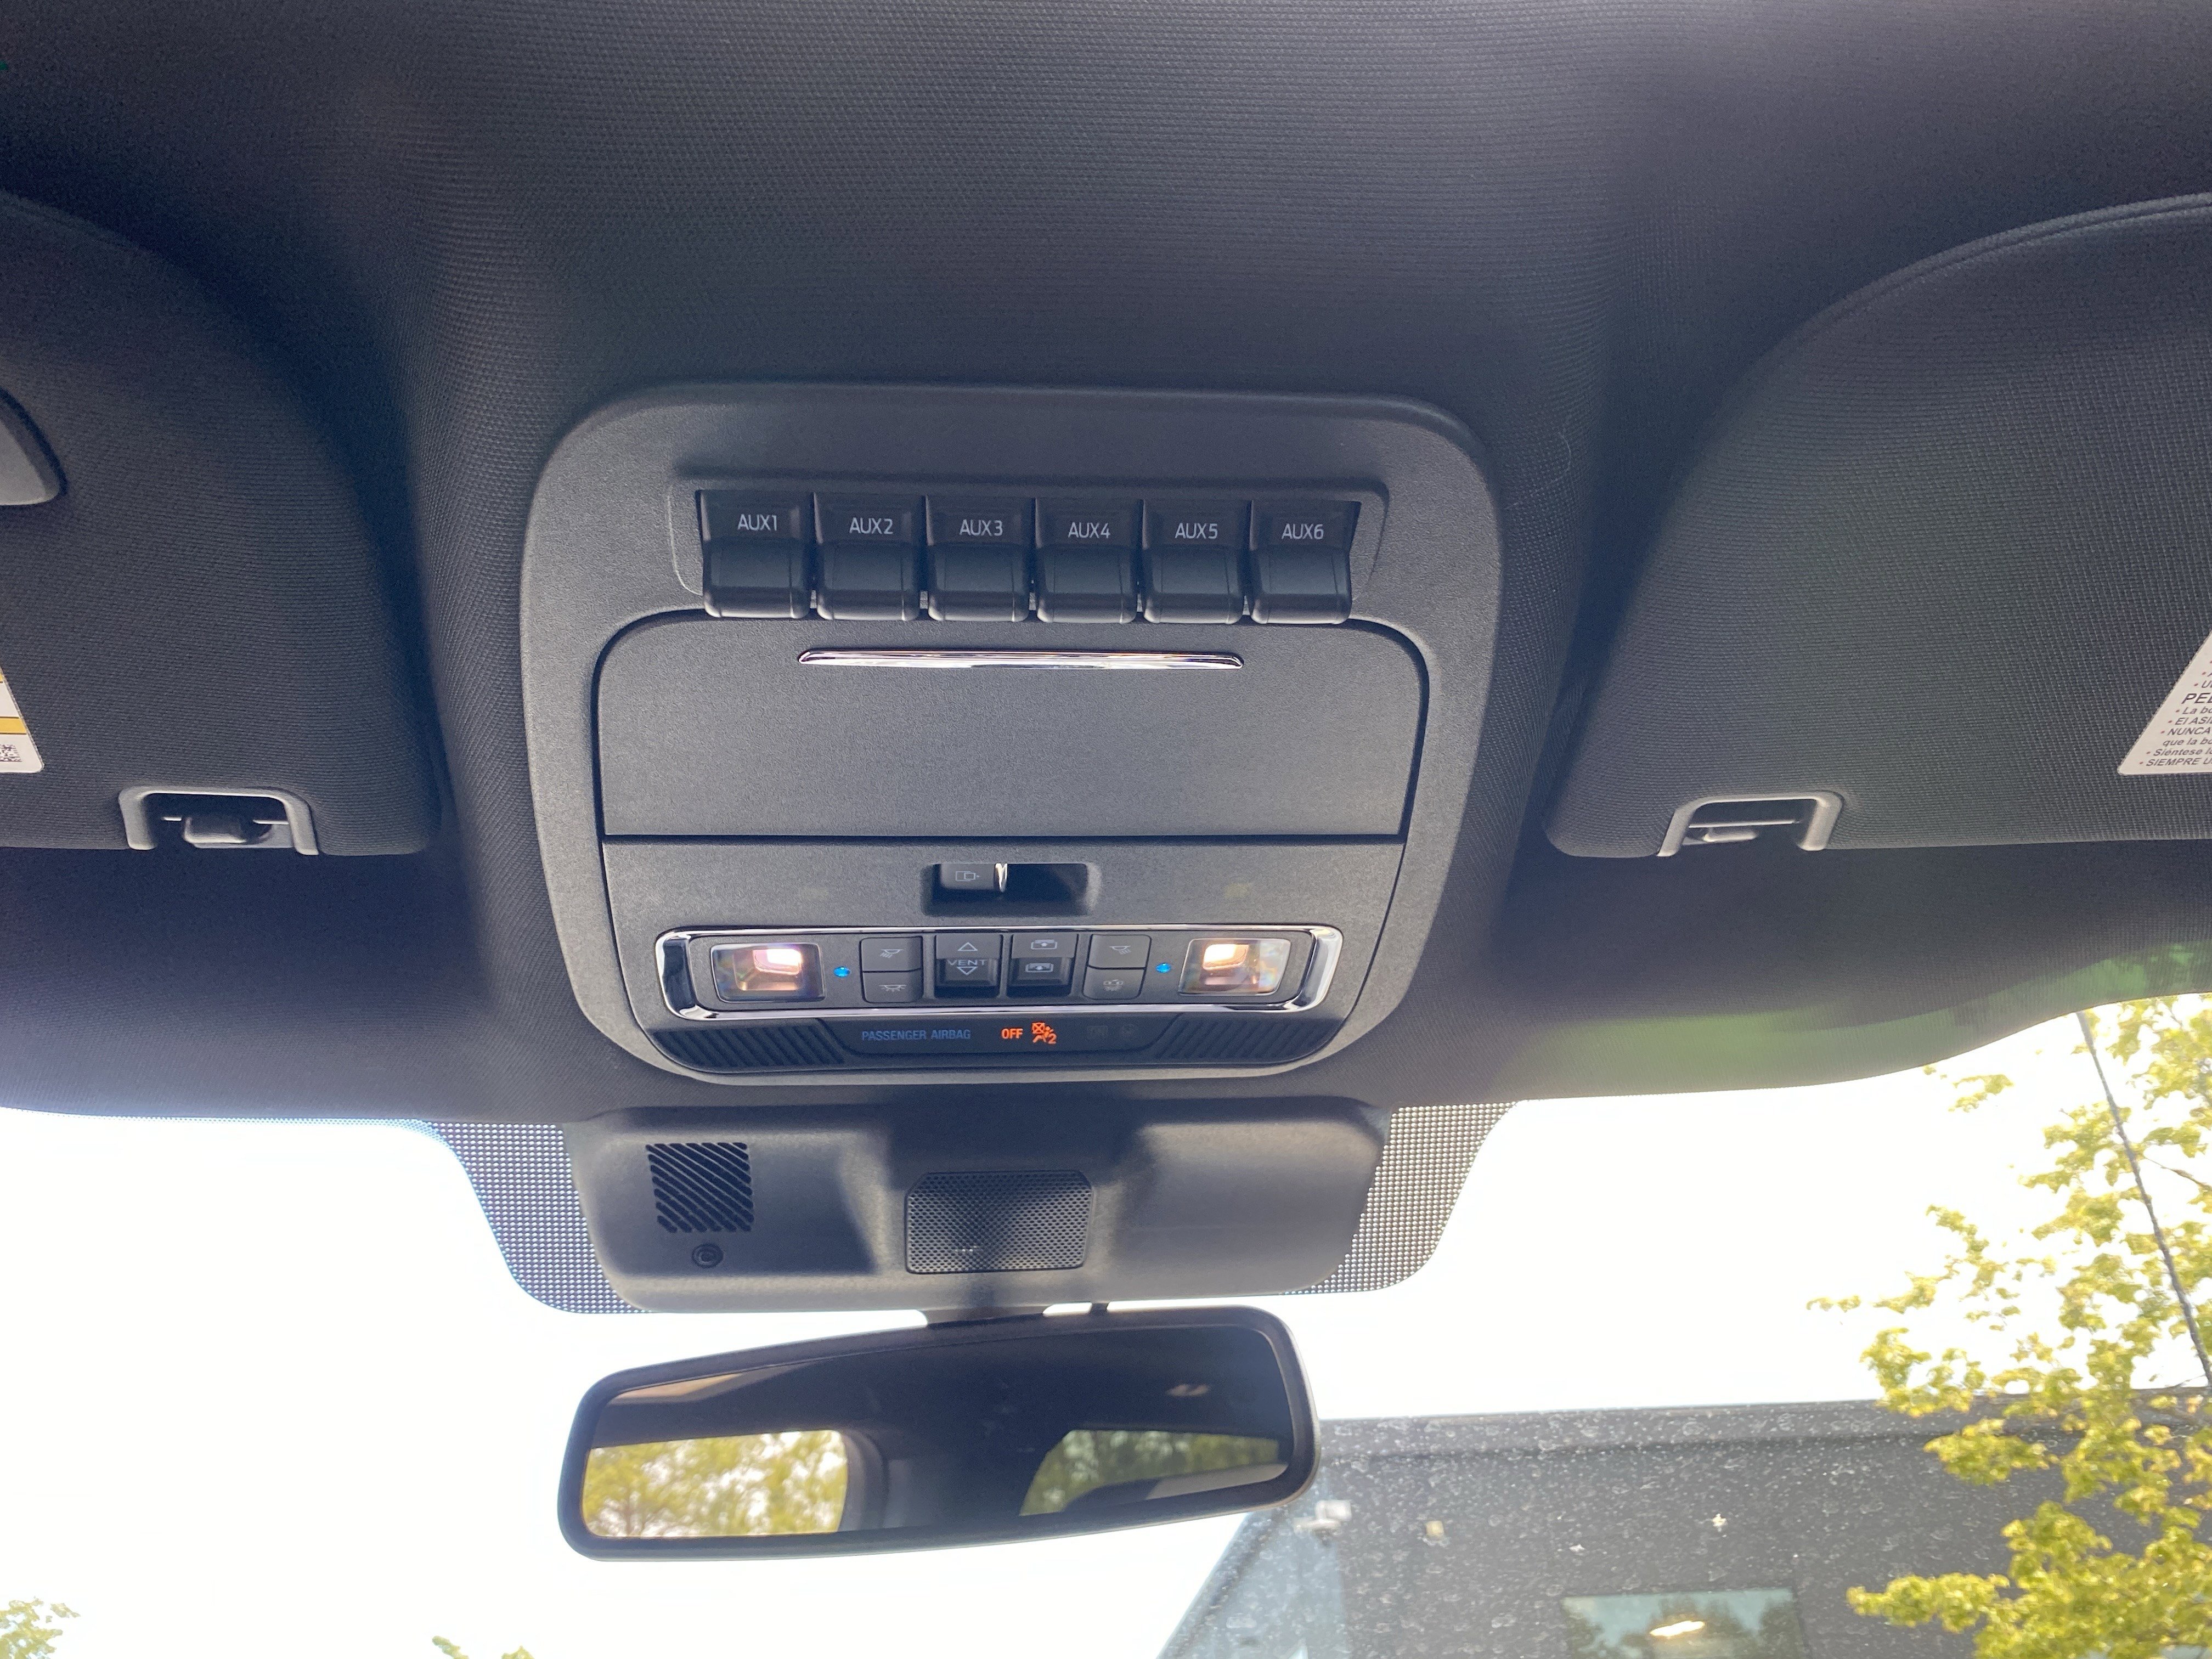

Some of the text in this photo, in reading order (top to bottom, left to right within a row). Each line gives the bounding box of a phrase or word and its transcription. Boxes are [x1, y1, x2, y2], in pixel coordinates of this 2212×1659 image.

[737, 514, 778, 531] AUX1
[849, 517, 893, 535] AUX2
[958, 519, 1003, 537] AUX3
[1068, 522, 1111, 539] AUX4
[1175, 522, 1218, 539] AUX5
[1281, 523, 1324, 540] AUX6
[2167, 726, 2210, 736] NUNCA
[2162, 738, 2184, 747] que
[2153, 747, 2203, 756] Siéntese
[2146, 758, 2202, 766] SIEMPRE
[861, 1030, 927, 1041] PASSENGER
[930, 1029, 971, 1040] AIRBAG
[1001, 1027, 1024, 1039] OFF
